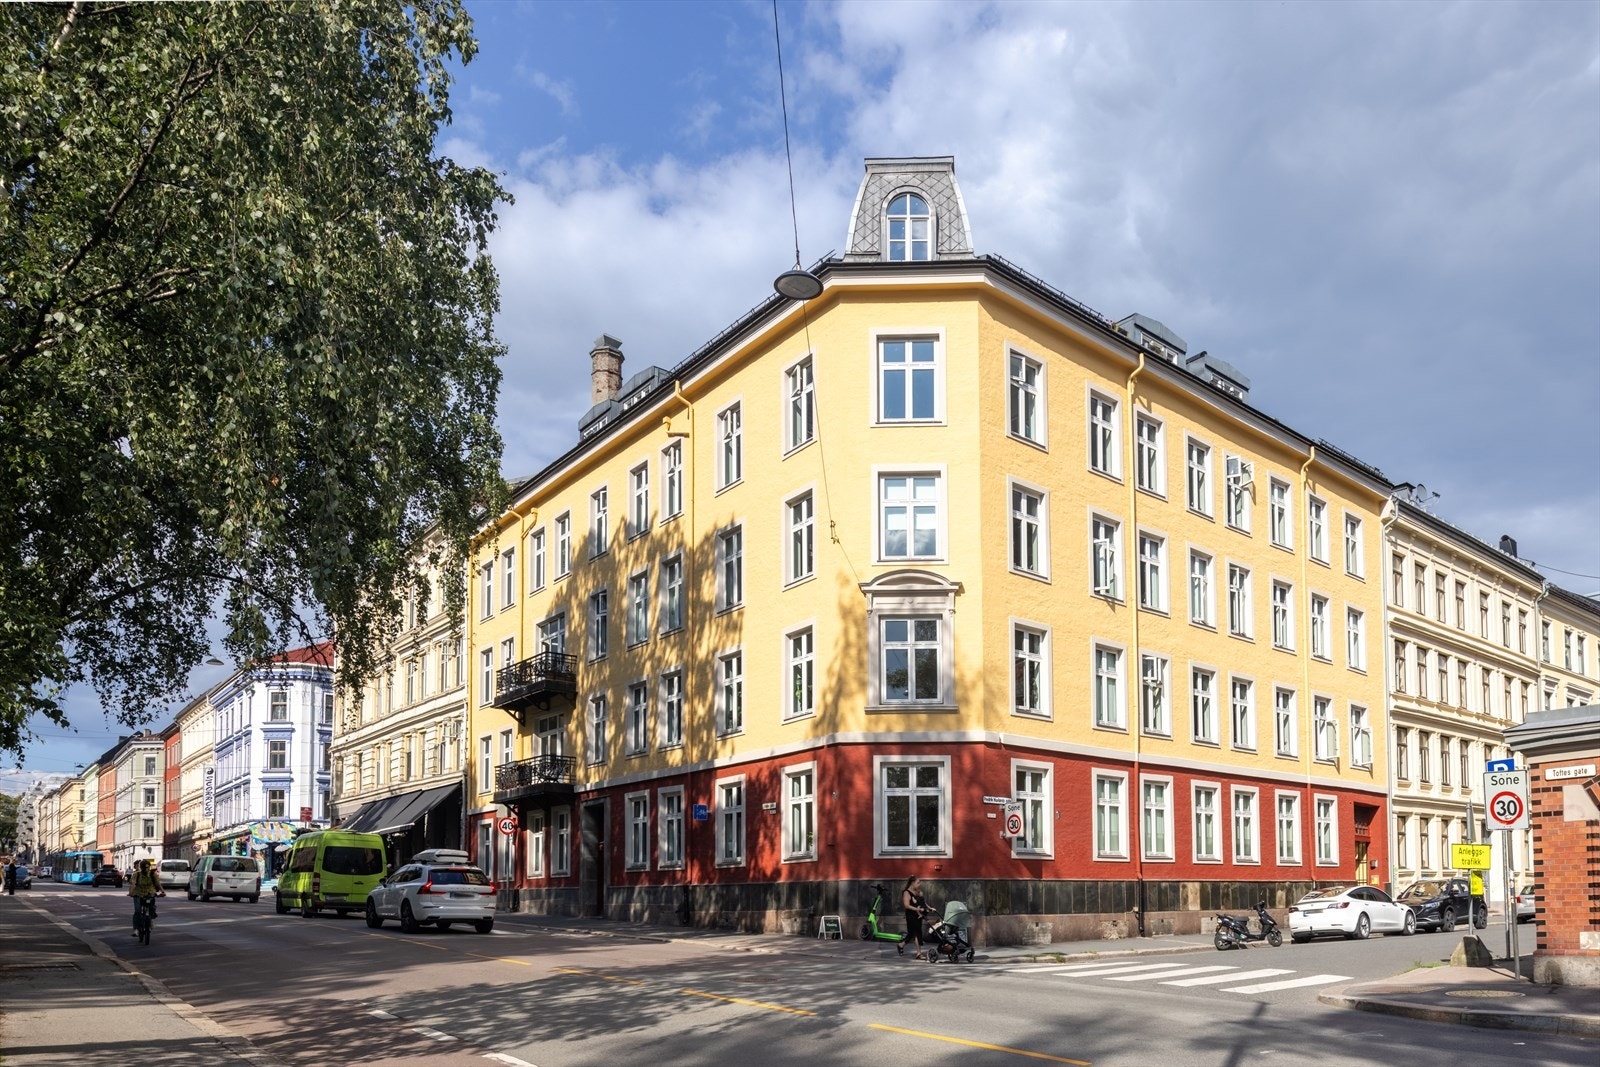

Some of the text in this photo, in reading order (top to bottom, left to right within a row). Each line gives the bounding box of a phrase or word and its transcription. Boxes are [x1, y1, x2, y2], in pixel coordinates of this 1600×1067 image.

[1552, 768, 1588, 777] Toftes gate
[1490, 775, 1520, 786] Sone
[1496, 799, 1518, 817] 30
[502, 822, 514, 830] 40
[1009, 820, 1018, 830] 30
[1458, 847, 1485, 857] Anleggs-
[1461, 858, 1482, 866] trafikk
